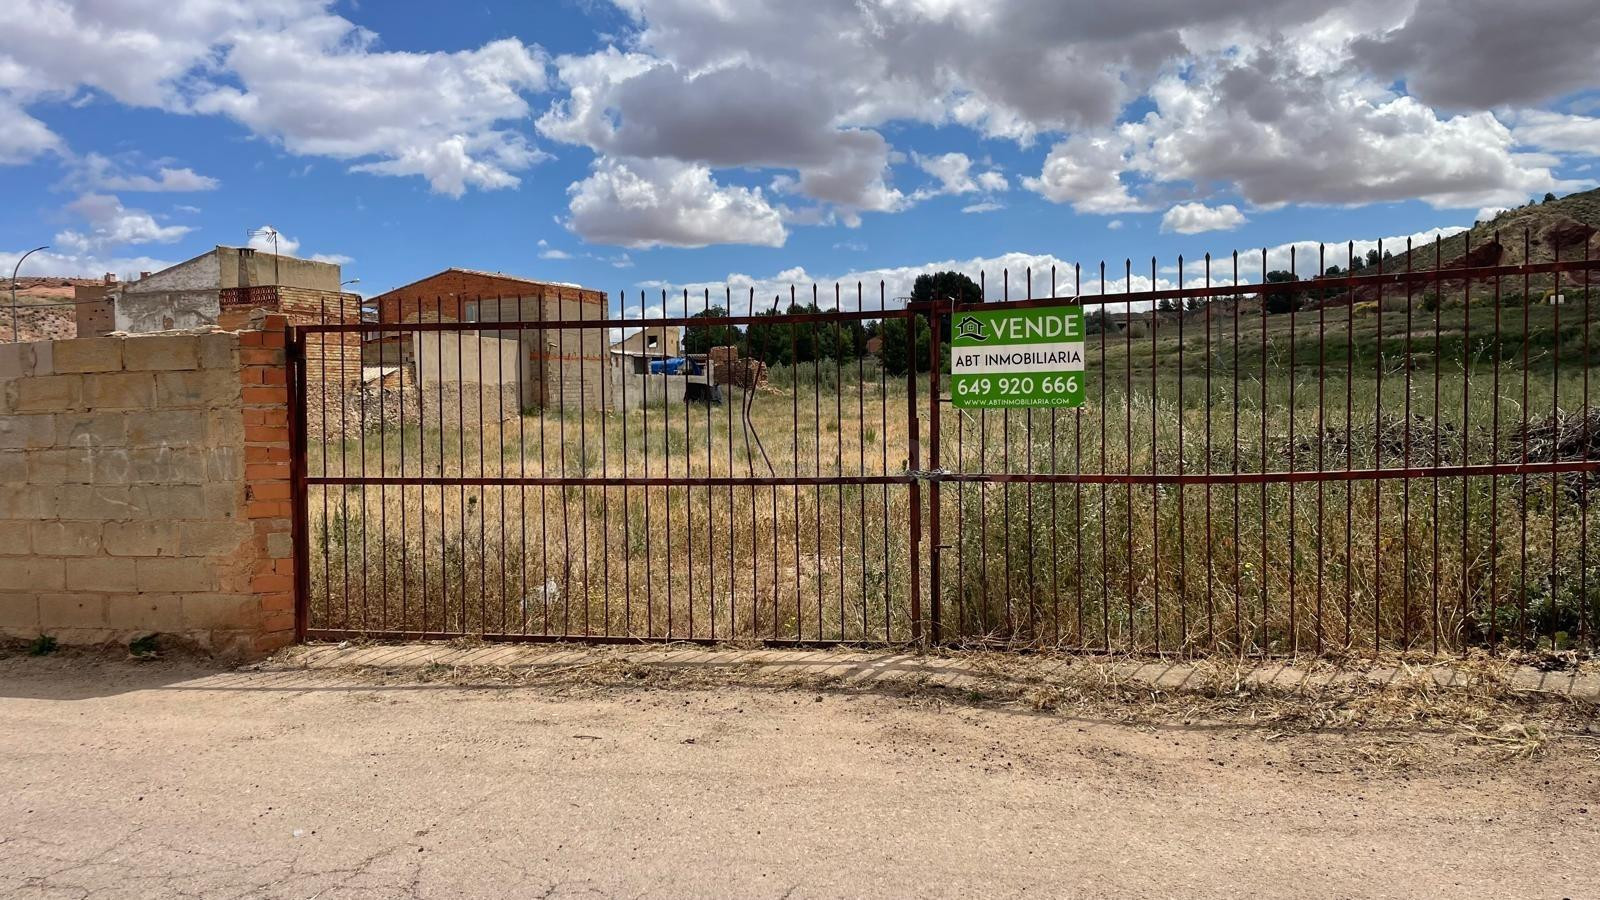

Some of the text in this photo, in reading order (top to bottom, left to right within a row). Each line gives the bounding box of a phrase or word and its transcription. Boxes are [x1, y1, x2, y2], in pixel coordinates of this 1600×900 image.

[990, 314, 1079, 340] VENDE
[956, 351, 1082, 367] ABT INMOBILIARIA
[958, 376, 1078, 395] 649 920 666
[964, 398, 1069, 406] WWW.ABTINMOBILIARIA.COM
